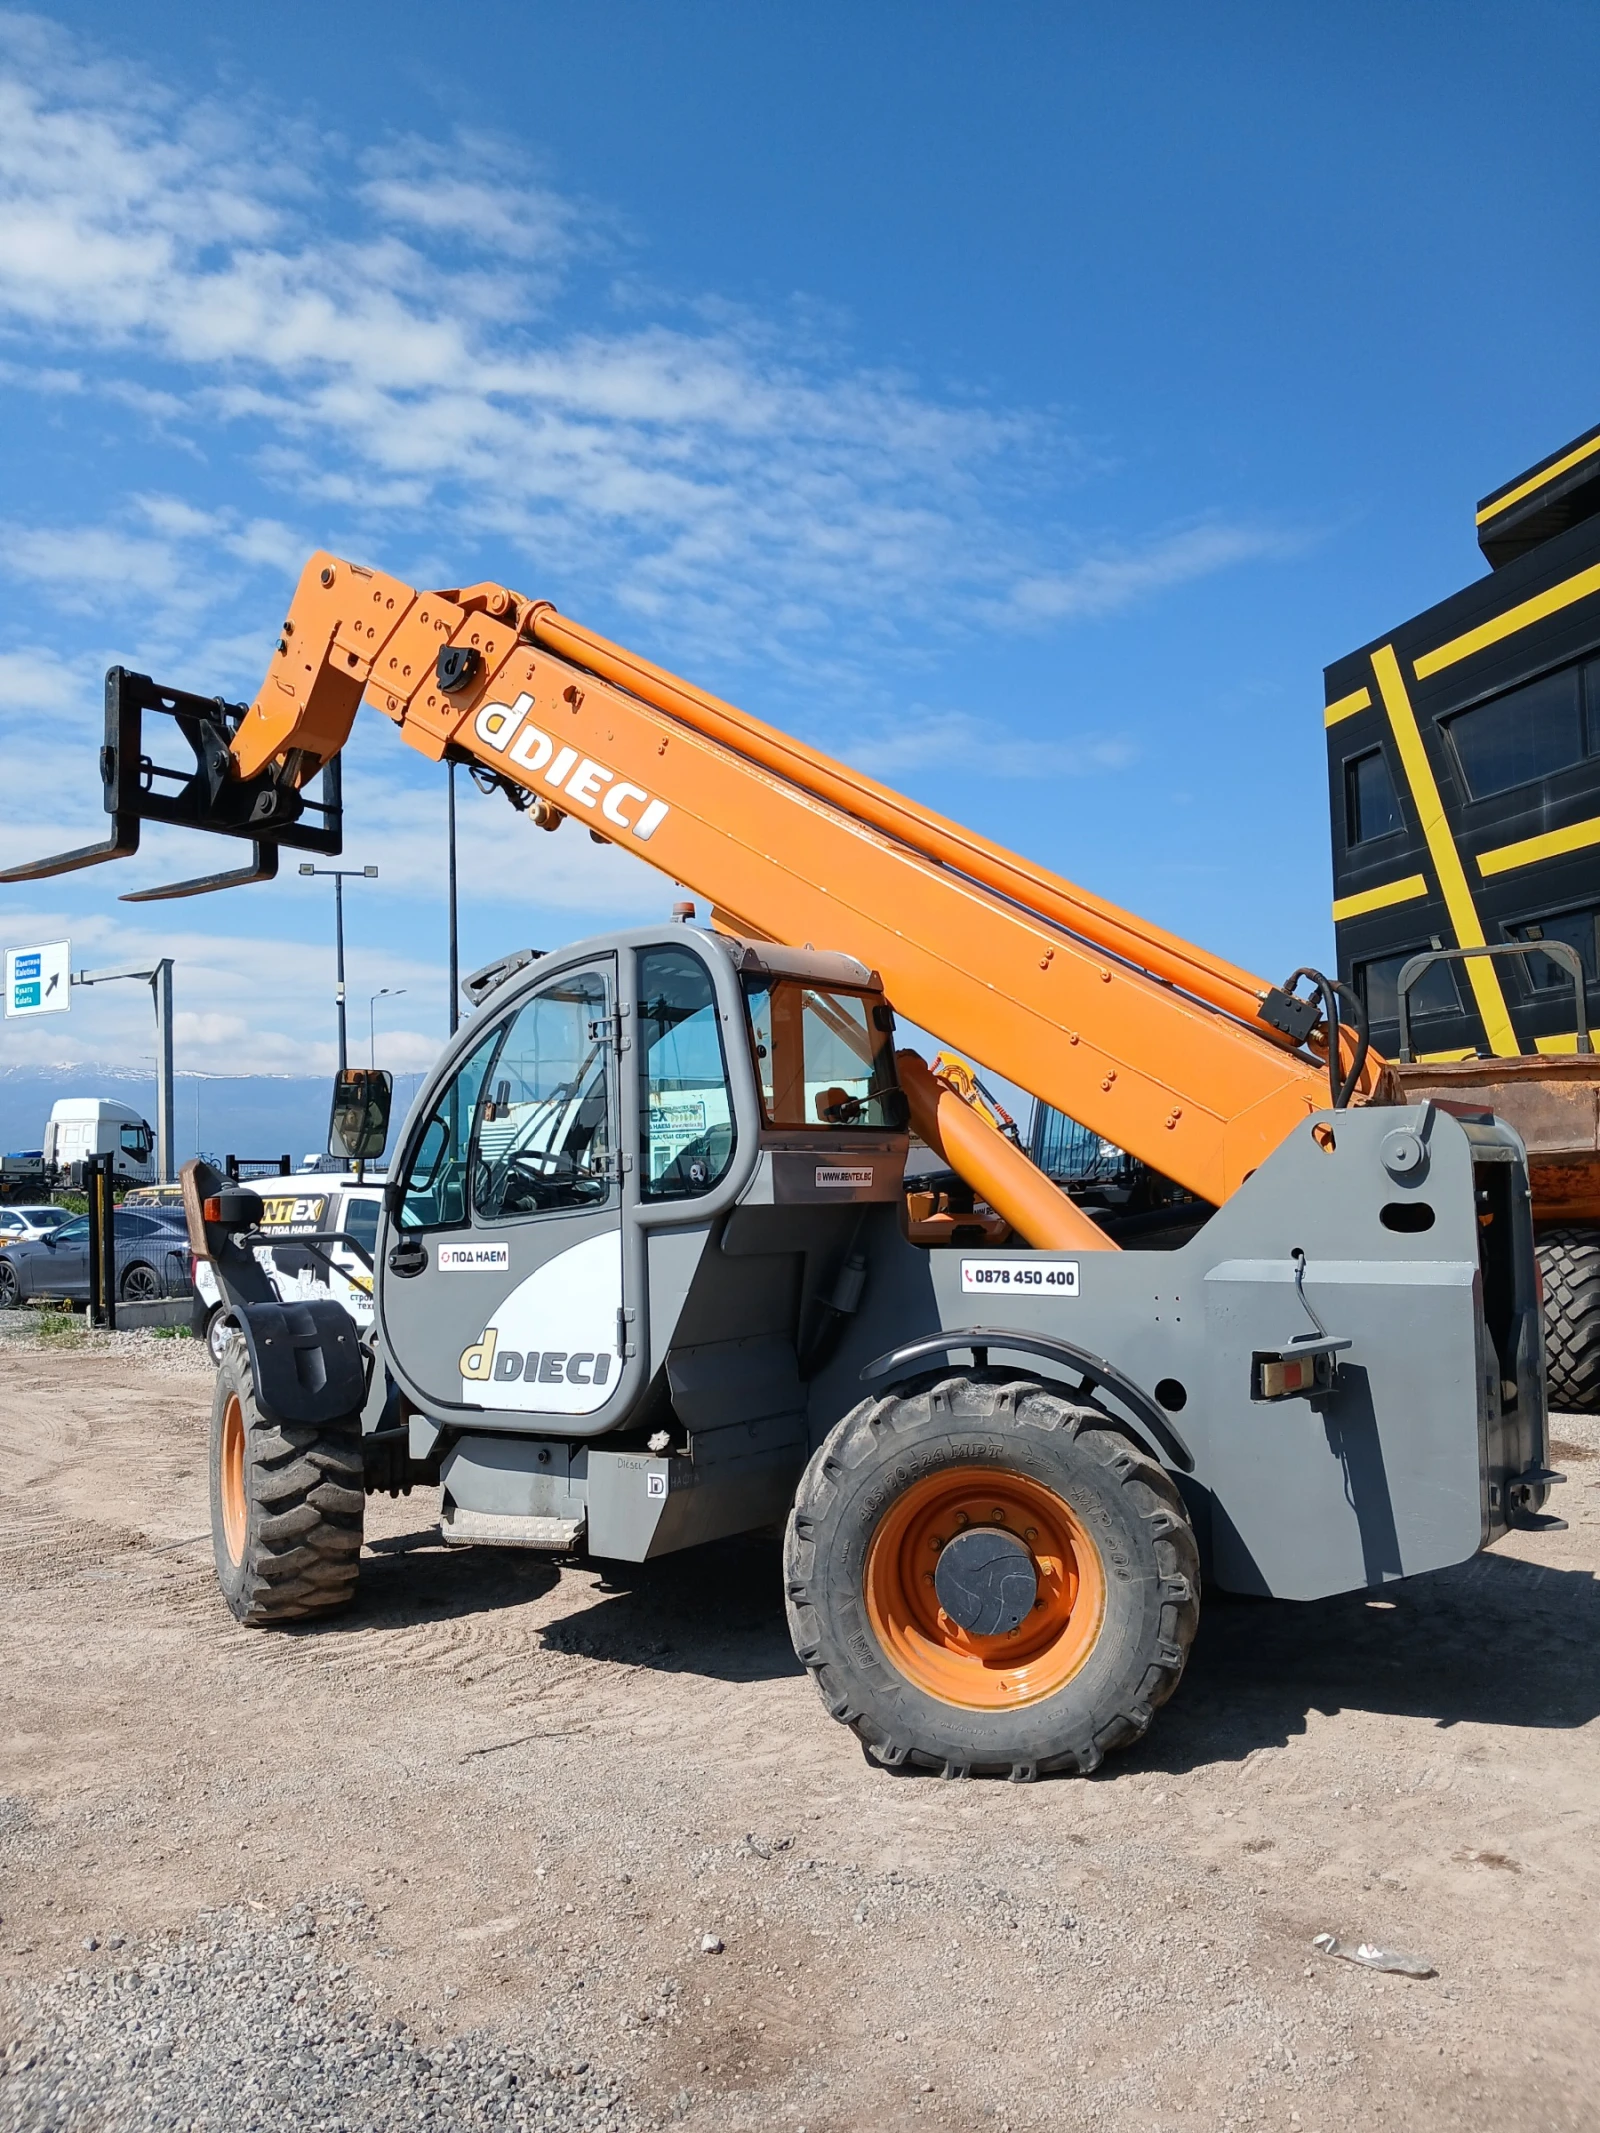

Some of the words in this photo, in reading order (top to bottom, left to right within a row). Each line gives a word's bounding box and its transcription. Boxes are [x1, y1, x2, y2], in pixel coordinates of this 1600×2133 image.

[822, 1172, 871, 1181] WWW.RENTEX.BG
[261, 1199, 321, 1222] NTEX
[452, 1251, 474, 1262] ПОД
[476, 1251, 506, 1262] НАЕМ
[976, 1270, 1010, 1283] 0878
[1013, 1270, 1042, 1284] 450
[1046, 1271, 1074, 1285] 400
